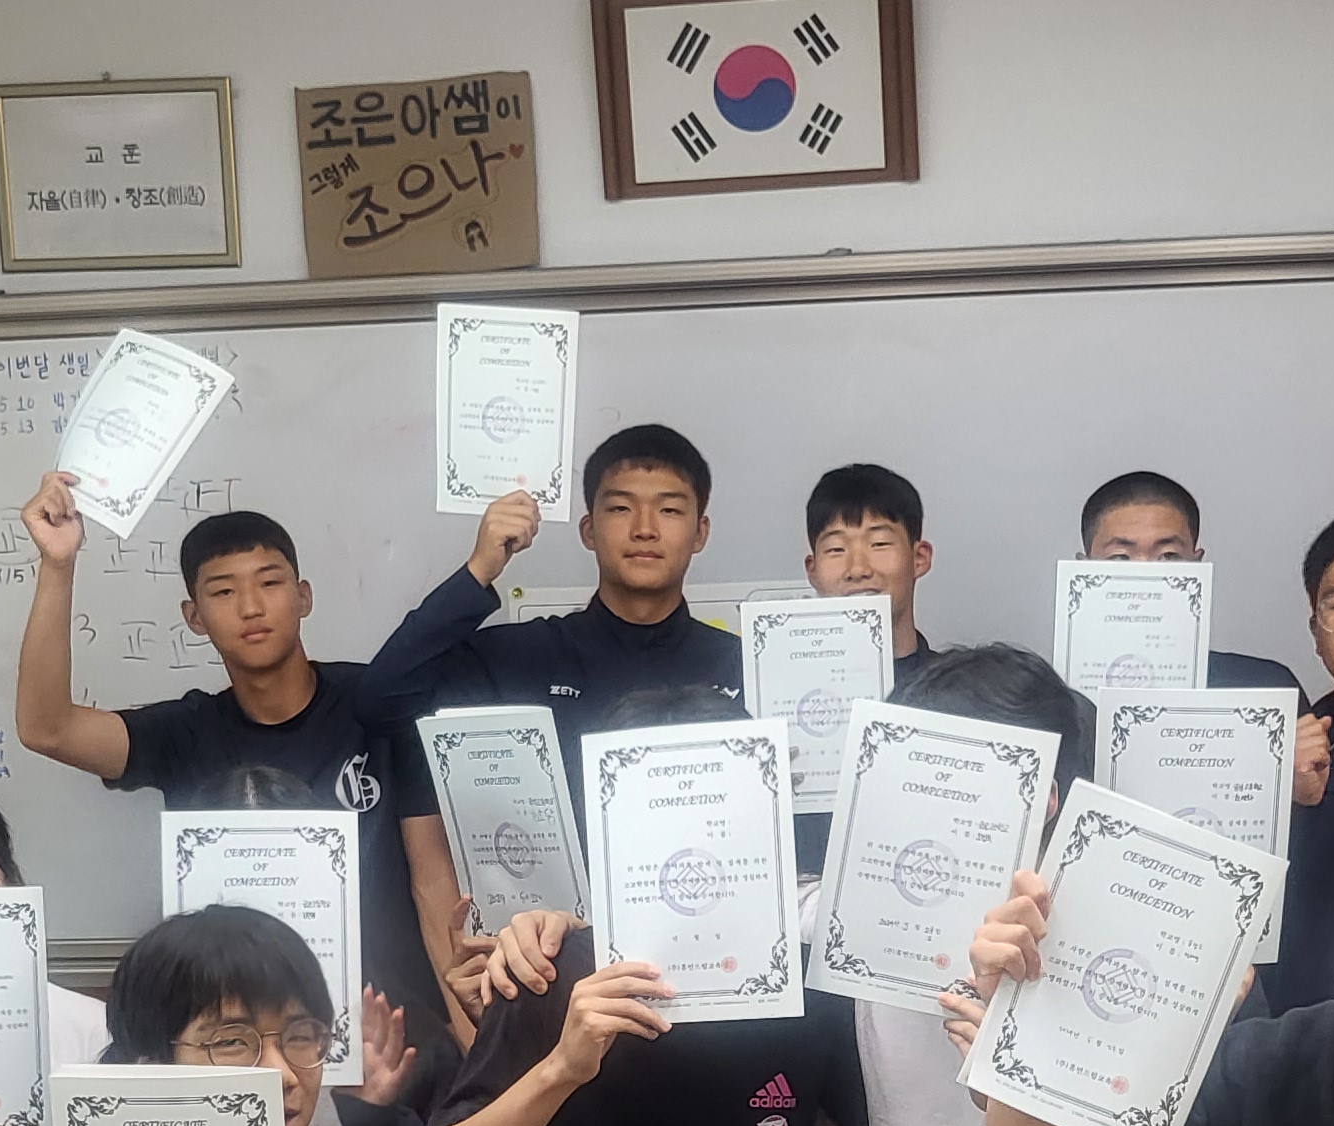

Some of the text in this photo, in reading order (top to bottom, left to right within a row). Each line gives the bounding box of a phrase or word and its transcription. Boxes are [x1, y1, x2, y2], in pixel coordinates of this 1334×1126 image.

[307, 79, 521, 148] 조은아쌤이
[309, 153, 359, 194] 그렇게
[344, 140, 505, 246] 조으나
[1160, 728, 1235, 739] CERTIFICATE
[1189, 744, 1206, 753] OF
[908, 751, 986, 773] CERTIFICATE
[1158, 757, 1235, 768] COMPLETION
[647, 762, 724, 778] CERTIFICATE
[935, 771, 952, 783] OF
[678, 780, 695, 791] OF
[902, 781, 981, 804] COMPLETION
[649, 793, 727, 810] COMPLETION
[224, 847, 297, 858] CERTIFICATE
[253, 862, 269, 872] OF
[1122, 850, 1205, 887] CERTIFICATE
[224, 876, 299, 888] COMPLETION
[1148, 878, 1167, 892] OF
[1109, 882, 1195, 920] COMPLETION
